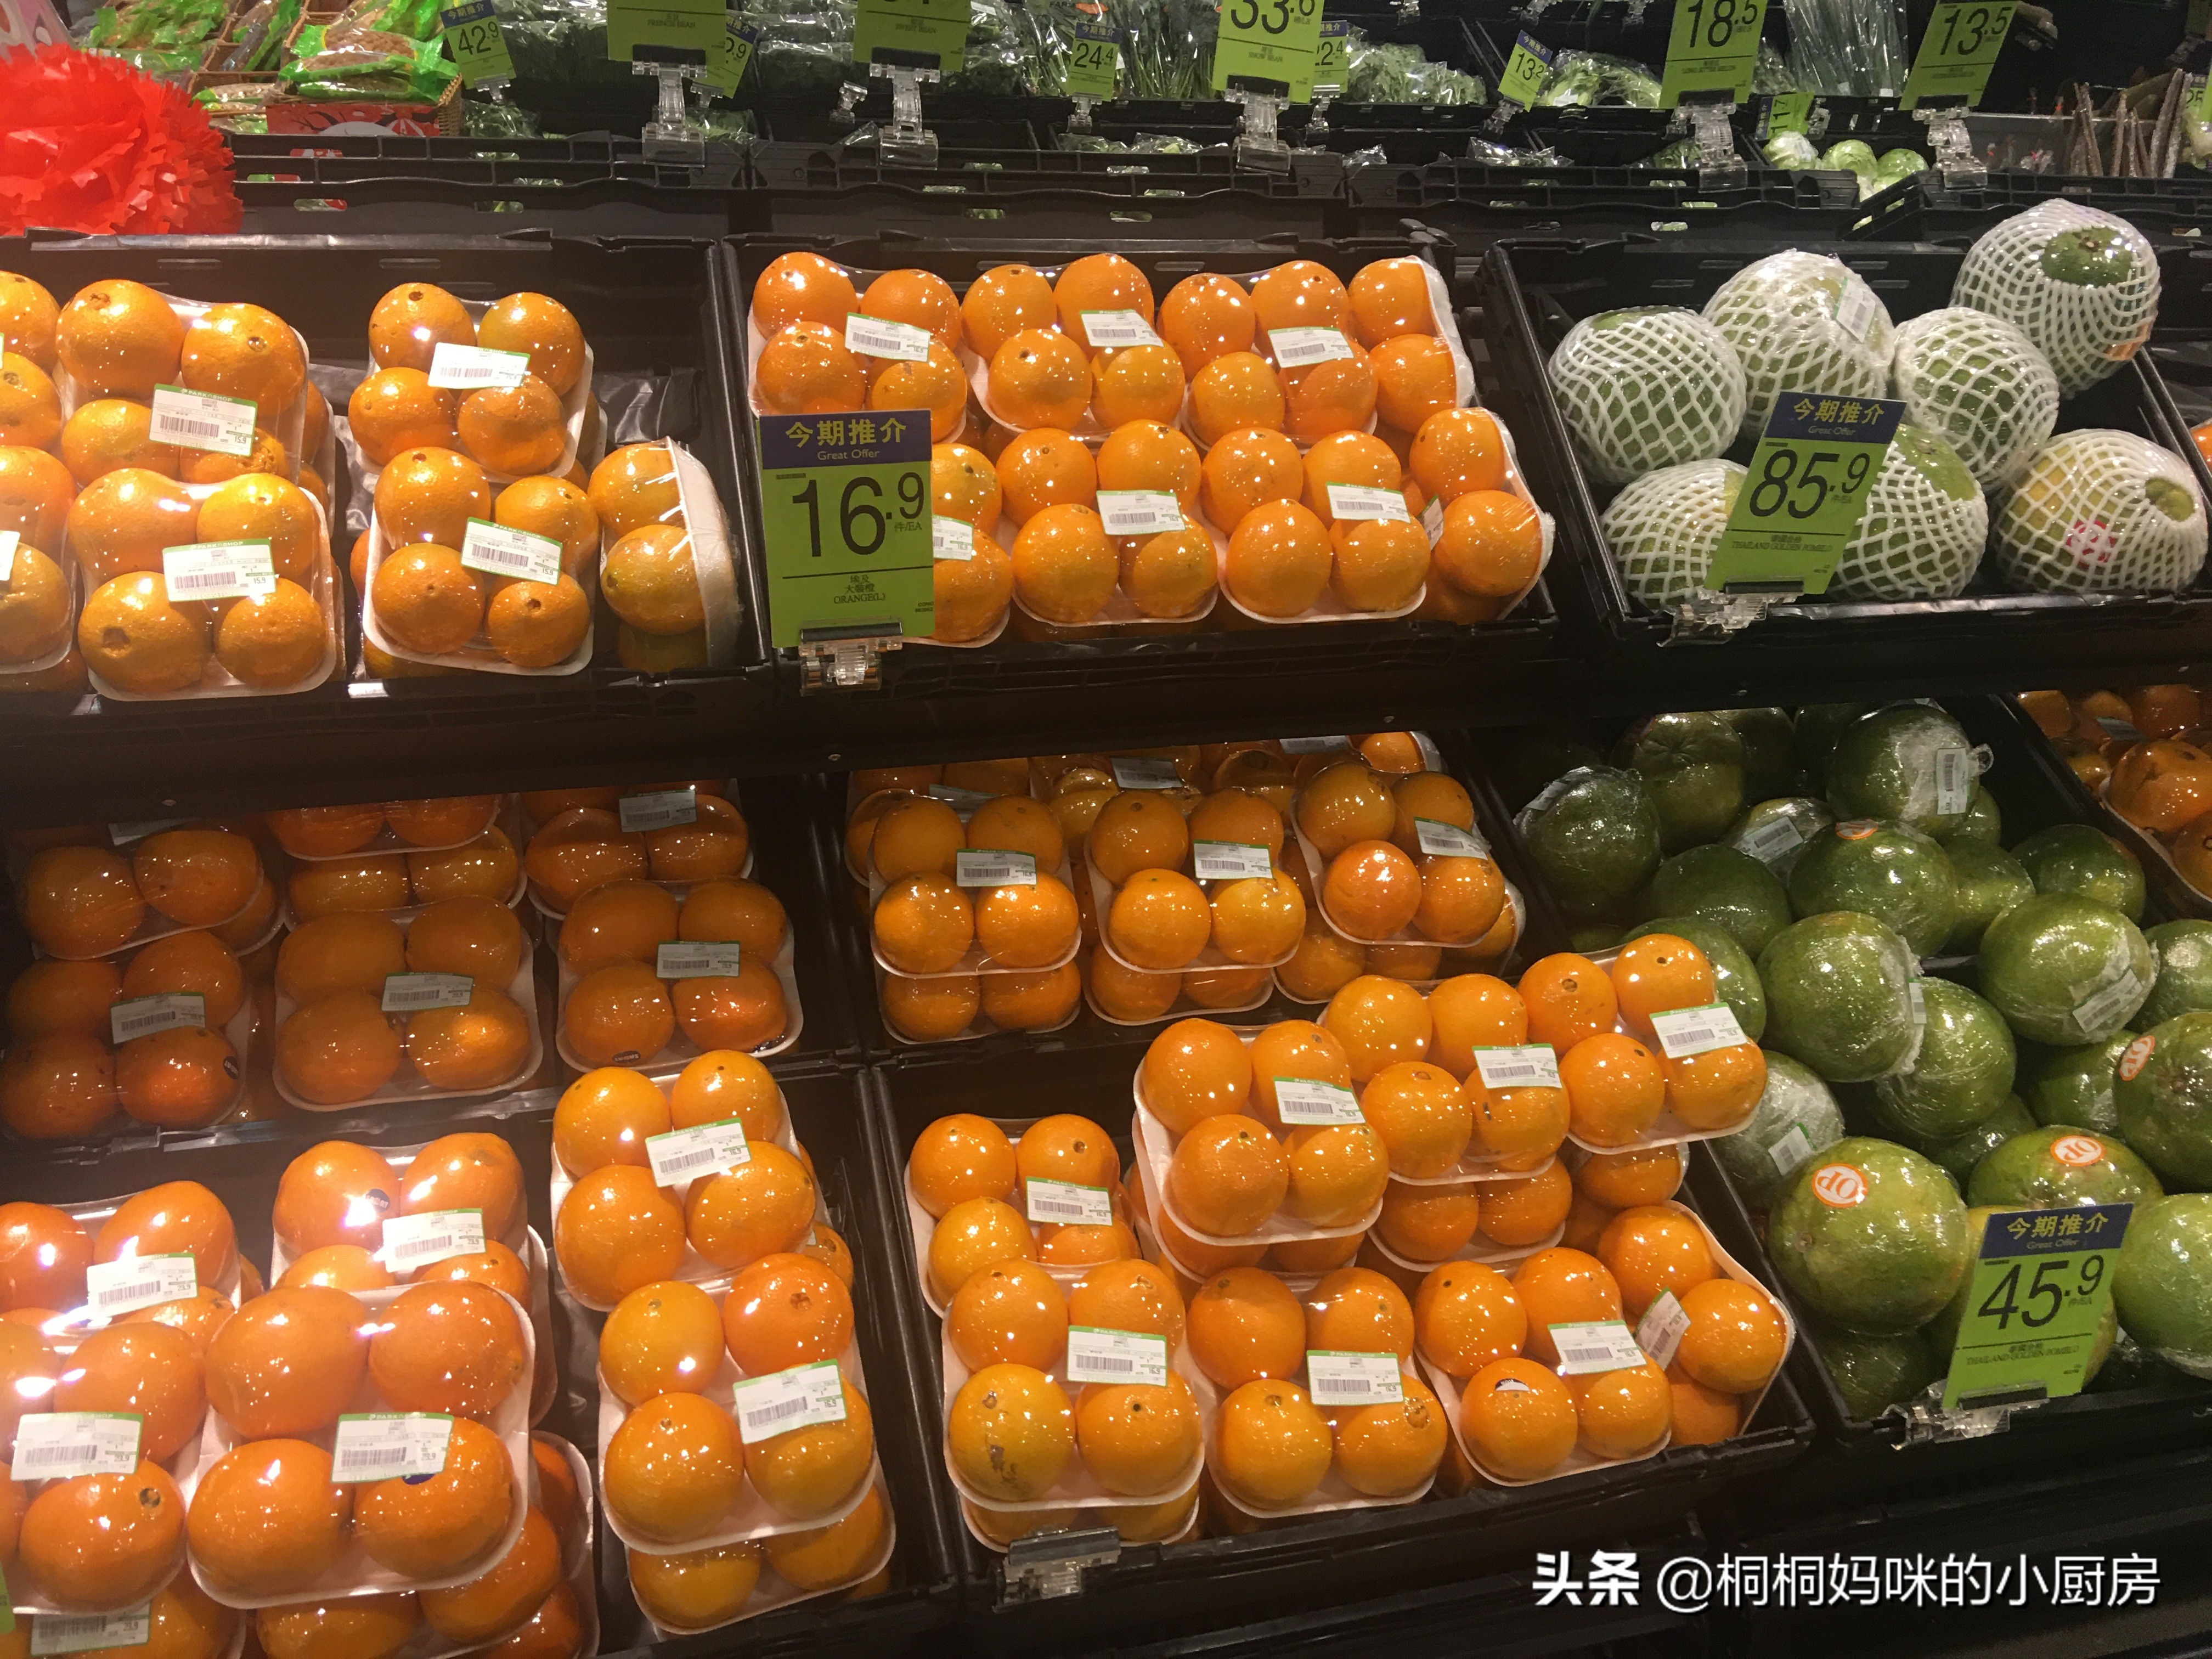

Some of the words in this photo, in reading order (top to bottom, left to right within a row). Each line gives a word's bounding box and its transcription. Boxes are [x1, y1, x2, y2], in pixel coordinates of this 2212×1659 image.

[1688, 0, 1758, 47] 18.5
[1940, 7, 2012, 55] 13.5
[459, 21, 499, 55] 42.9
[1074, 43, 1114, 70] 24.4
[1516, 53, 1544, 80] 13.2
[1793, 398, 1884, 425] 今期推介
[786, 417, 906, 448] 今期推介
[1808, 425, 1832, 435] Great
[1834, 427, 1856, 436] Offer
[817, 450, 848, 460] Great
[851, 449, 879, 459] Offer
[1750, 449, 1871, 519] 85.9
[793, 472, 924, 557] 16.9
[833, 592, 885, 604] ORANGE(L)
[2007, 1212, 2108, 1240] 今期推介
[2027, 1241, 2052, 1250] Great
[2056, 1239, 2080, 1248] Offer
[1977, 1254, 2104, 1330] 45.9
